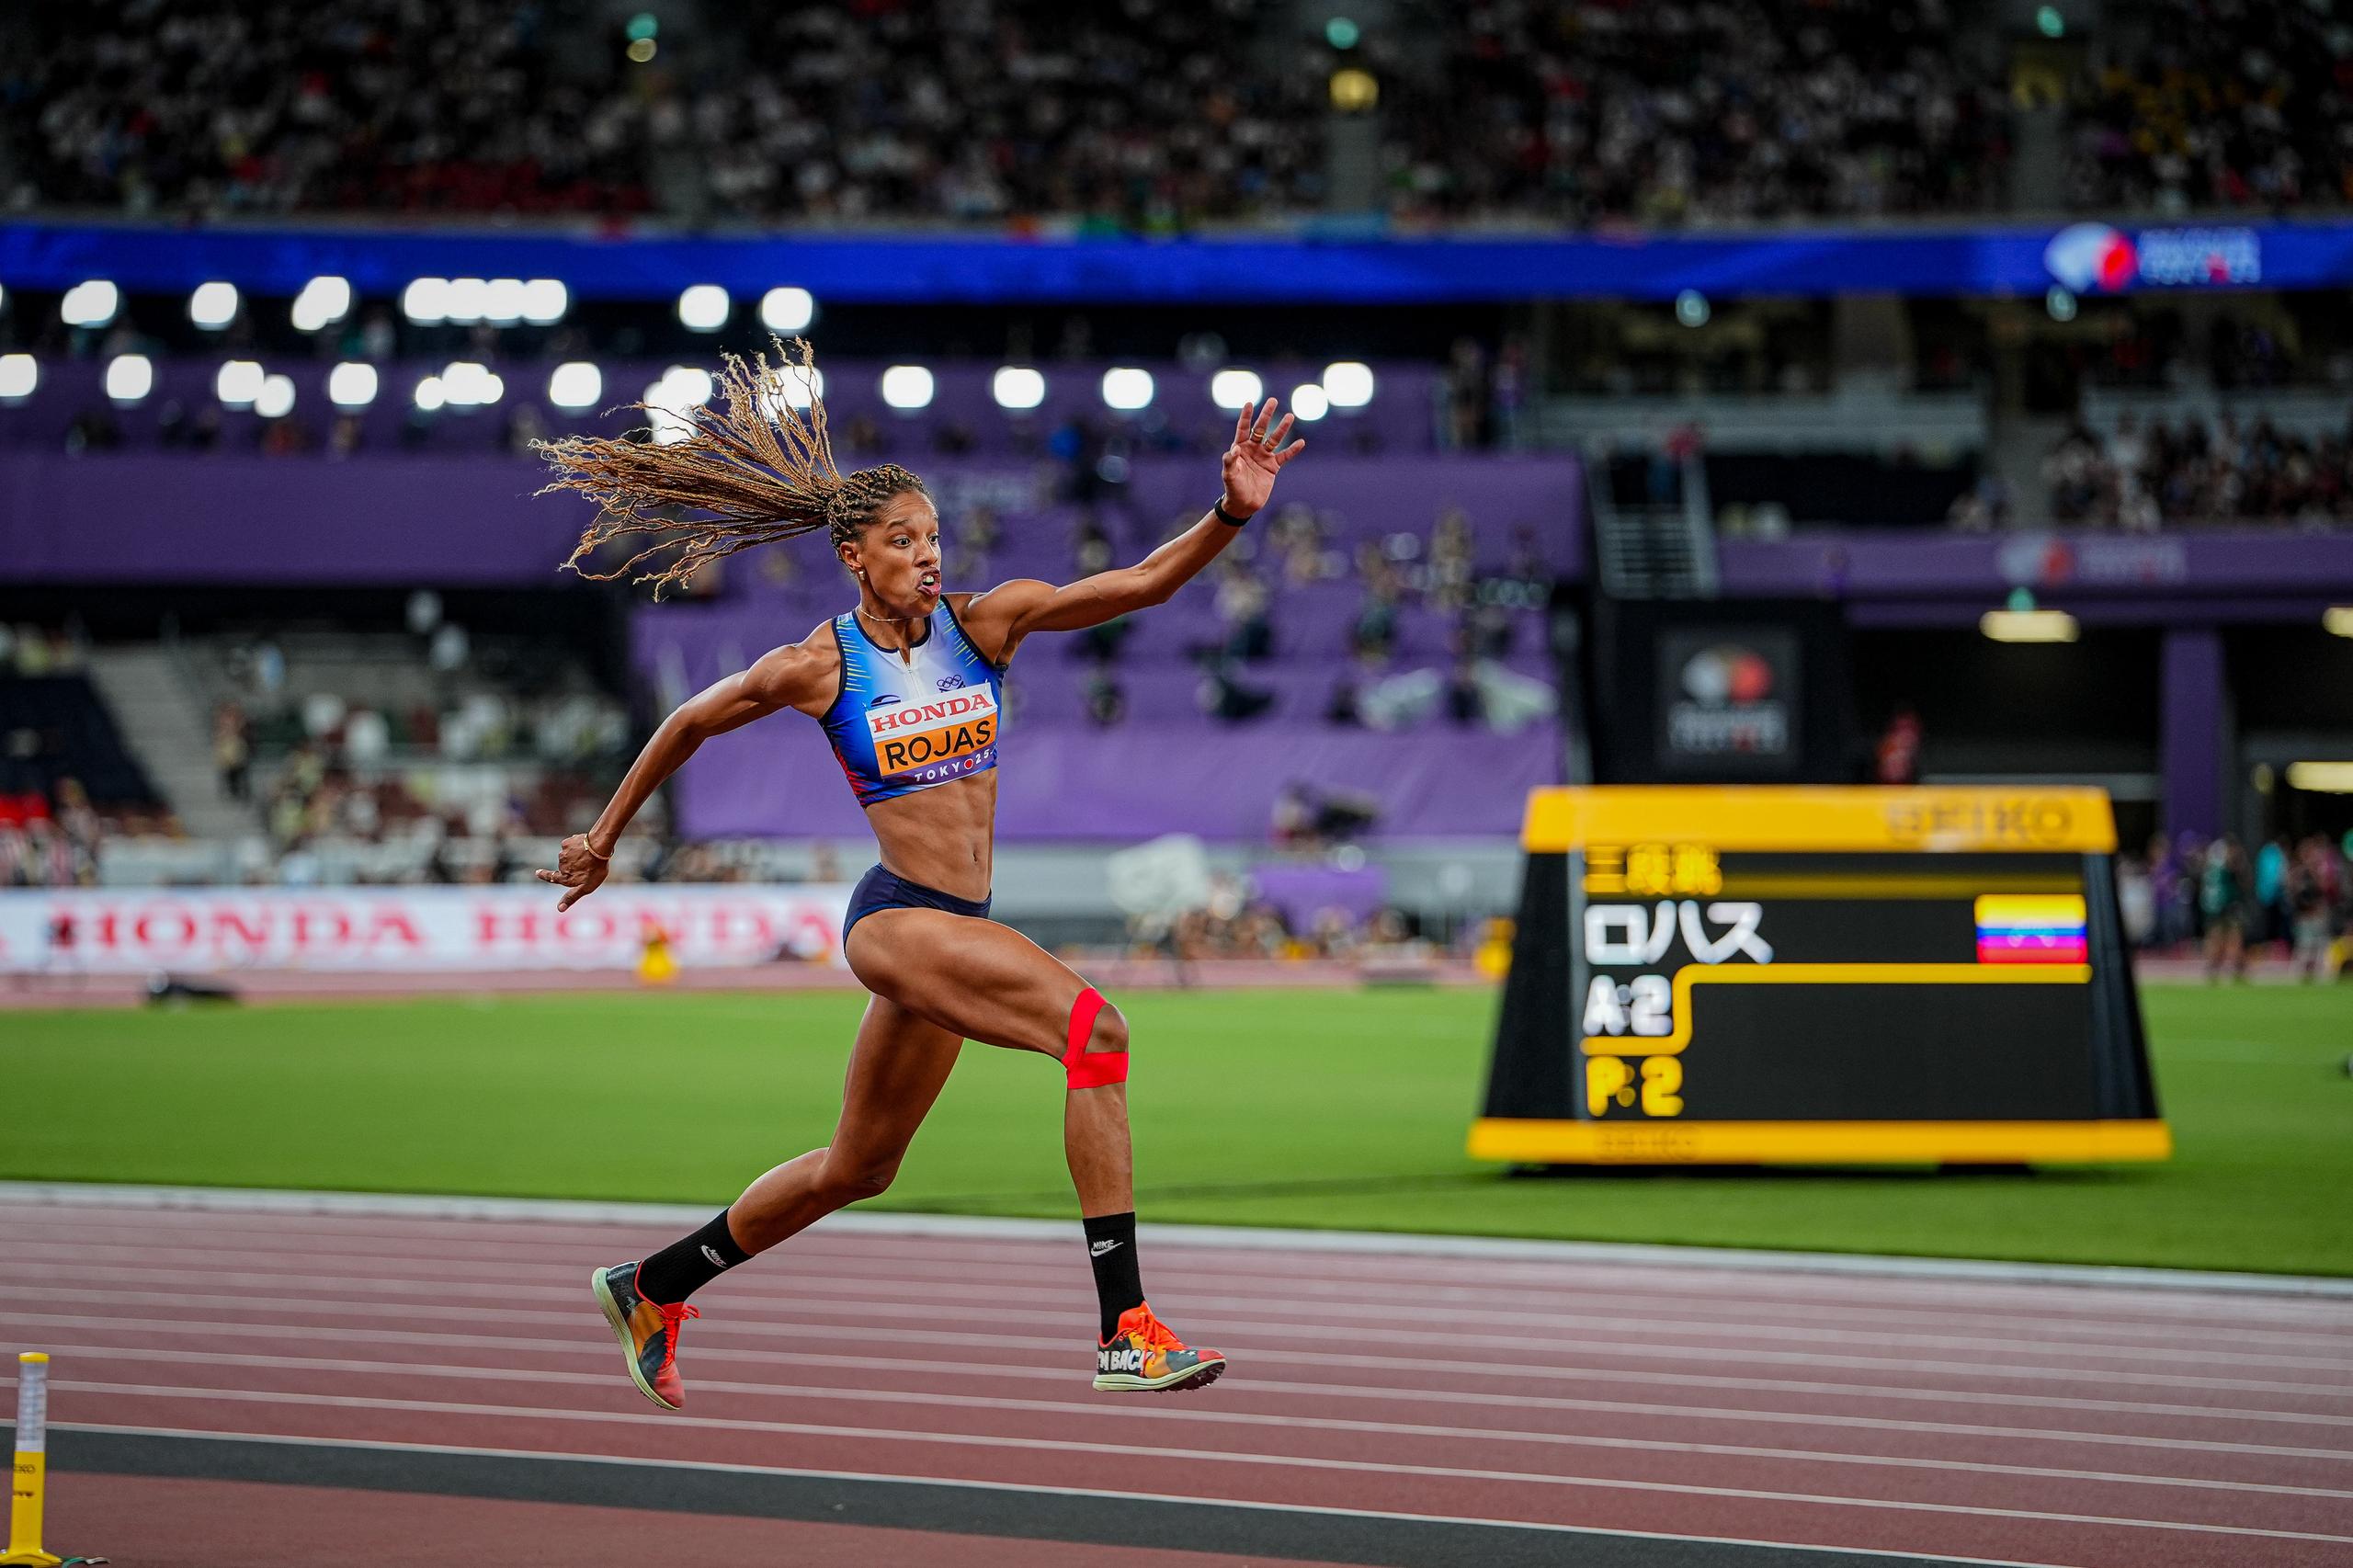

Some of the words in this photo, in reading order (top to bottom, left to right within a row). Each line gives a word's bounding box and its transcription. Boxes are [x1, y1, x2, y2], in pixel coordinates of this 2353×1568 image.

[870, 693, 993, 733] HONDA
[884, 720, 991, 770] ROJAS
[51, 903, 422, 951] HONDA
[475, 903, 836, 948] HONDA
[1585, 900, 1775, 964] ロハス
[1093, 1239, 1115, 1250] NIKE
